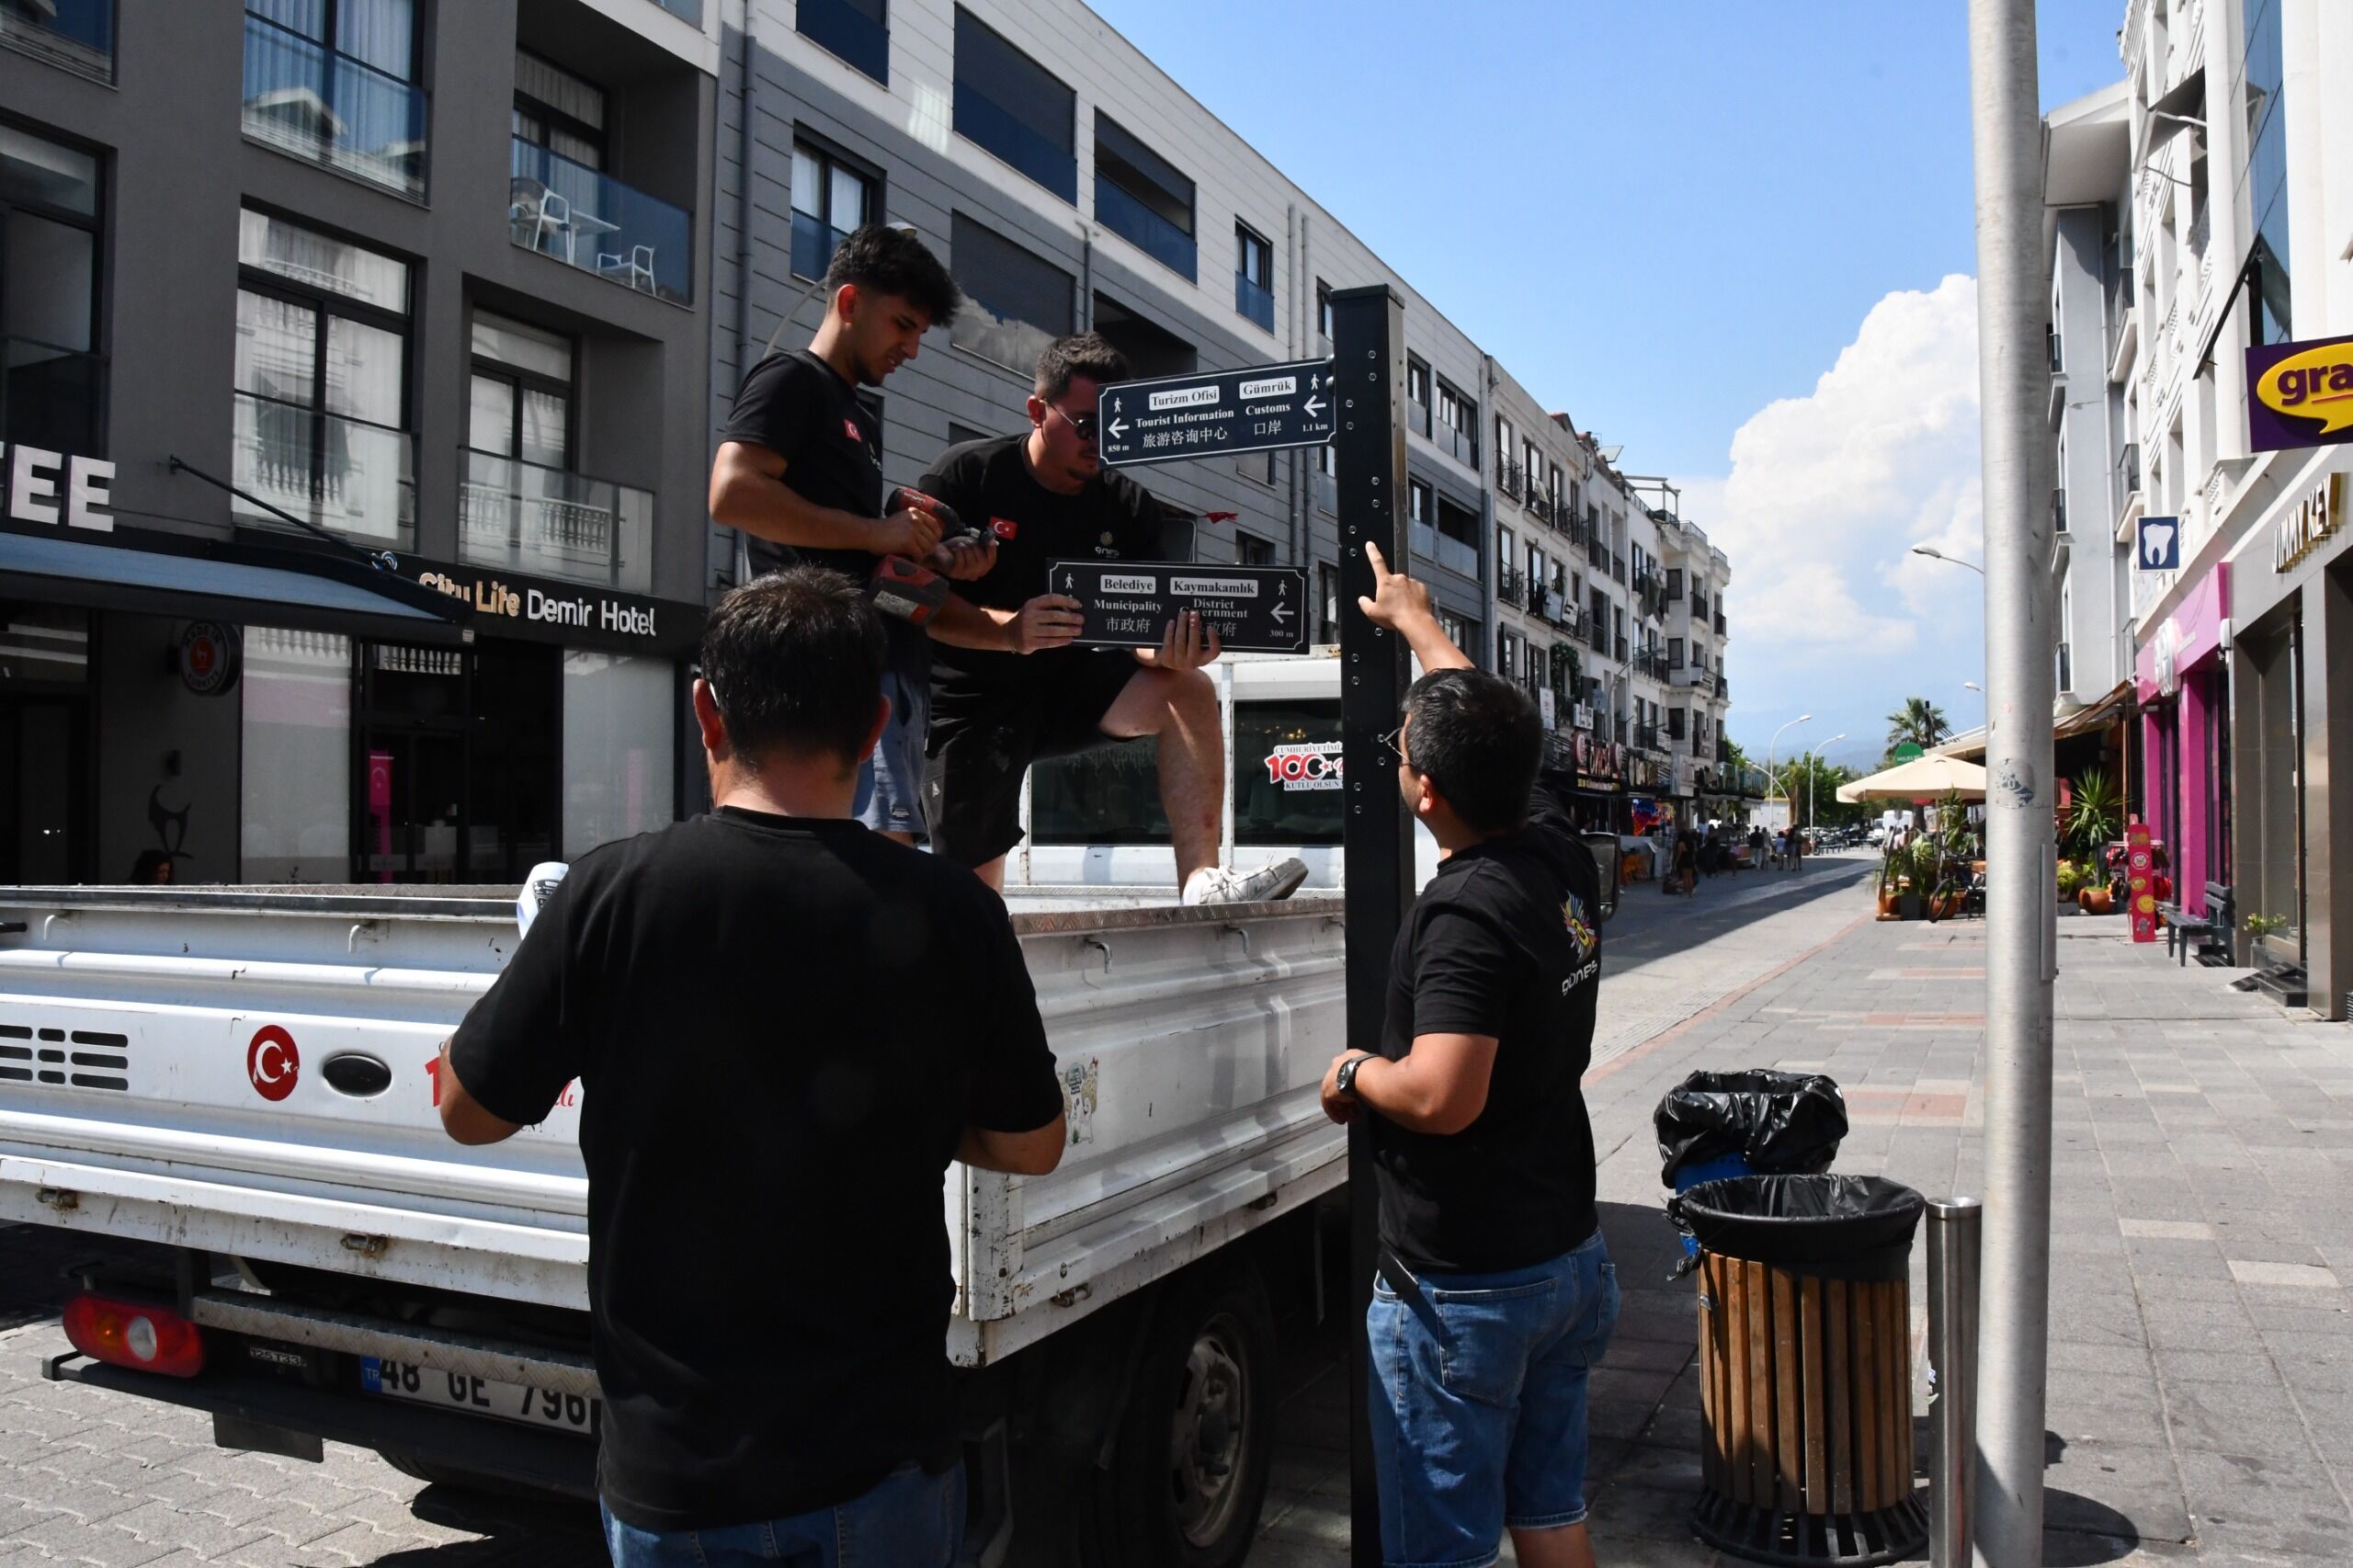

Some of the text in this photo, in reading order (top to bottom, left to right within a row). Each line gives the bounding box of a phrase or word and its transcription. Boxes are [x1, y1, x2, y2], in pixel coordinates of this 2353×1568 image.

[1243, 380, 1292, 395] Gümrük
[2277, 363, 2353, 406] gra
[1151, 389, 1217, 407] Turizm Ofisi
[1245, 403, 1290, 416] Customs
[1135, 408, 1234, 428] Tourist Information
[1254, 419, 1282, 436] 口岸
[1302, 422, 1328, 432] 1.1 km
[1142, 426, 1228, 449] 旅游咨询中心
[1107, 444, 1121, 452] 850
[0, 441, 116, 532] EE
[1104, 577, 1154, 593] Belediye
[1173, 580, 1255, 596] Kaymakamlık
[475, 580, 520, 617] Life
[527, 588, 593, 627] Demir
[601, 599, 656, 636] Hotel
[1094, 598, 1163, 613] Municipality
[1194, 597, 1234, 610] District
[1179, 606, 1248, 619] ernment
[1105, 617, 1151, 633] 市政府
[1200, 620, 1237, 637] 政府
[1268, 630, 1284, 638] 300
[365, 1367, 381, 1382] TR
[380, 1358, 421, 1393] 48
